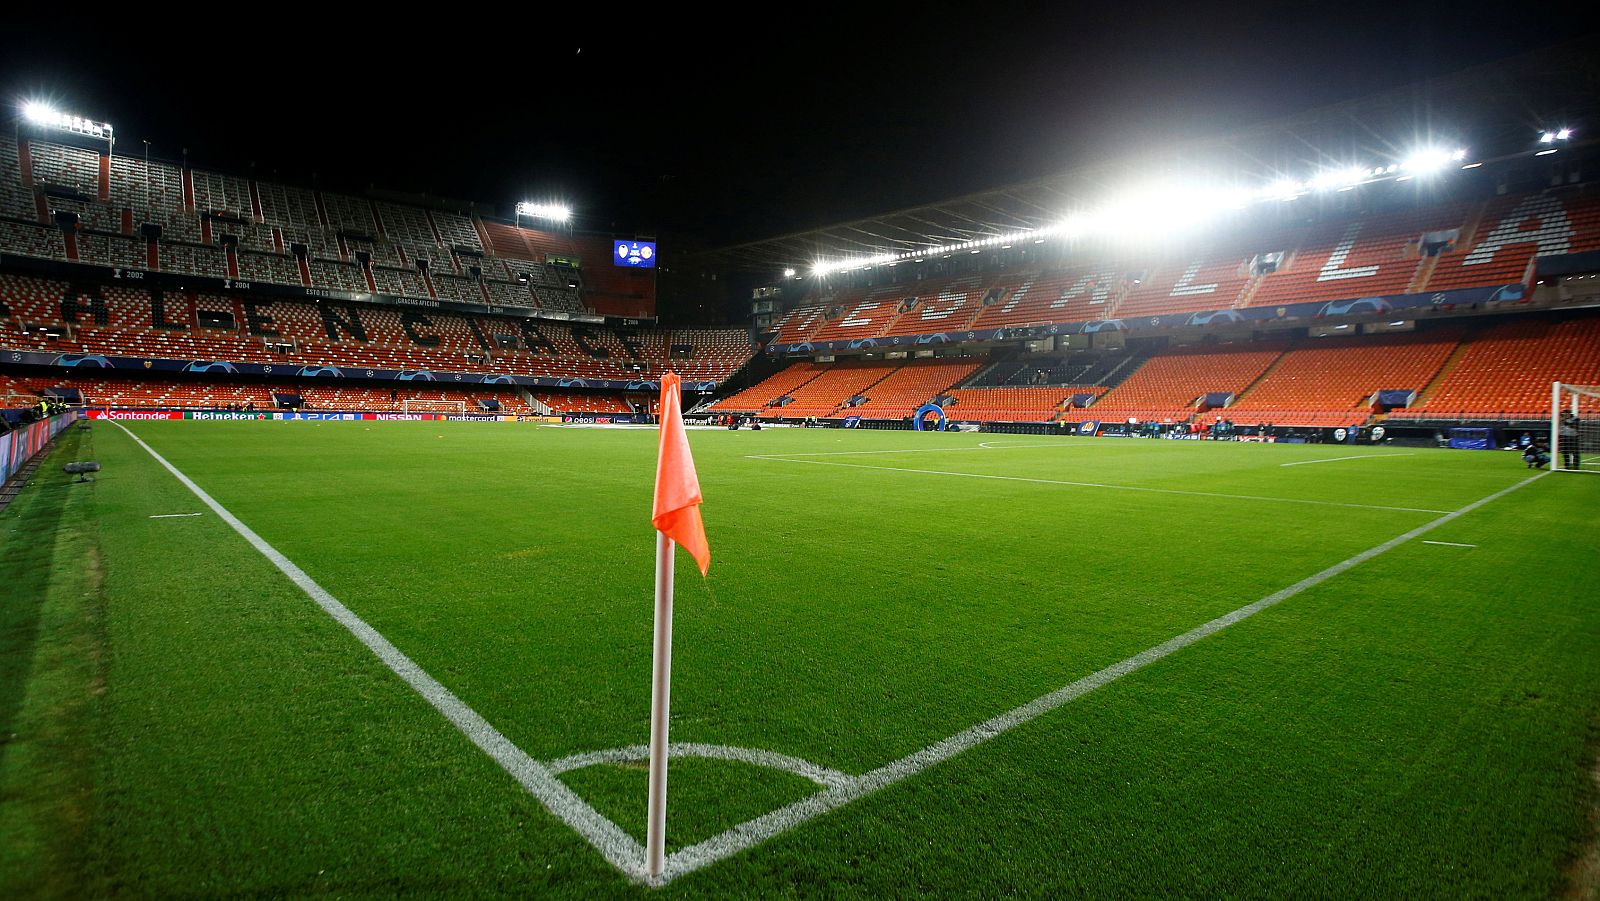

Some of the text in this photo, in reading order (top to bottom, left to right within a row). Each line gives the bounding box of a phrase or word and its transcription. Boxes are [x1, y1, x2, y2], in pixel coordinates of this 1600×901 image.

[126, 271, 144, 279] 2002
[306, 288, 321, 297] ESTO
[109, 411, 171, 420] Santander
[193, 412, 254, 420] Heineken
[448, 414, 495, 422] mastercard
